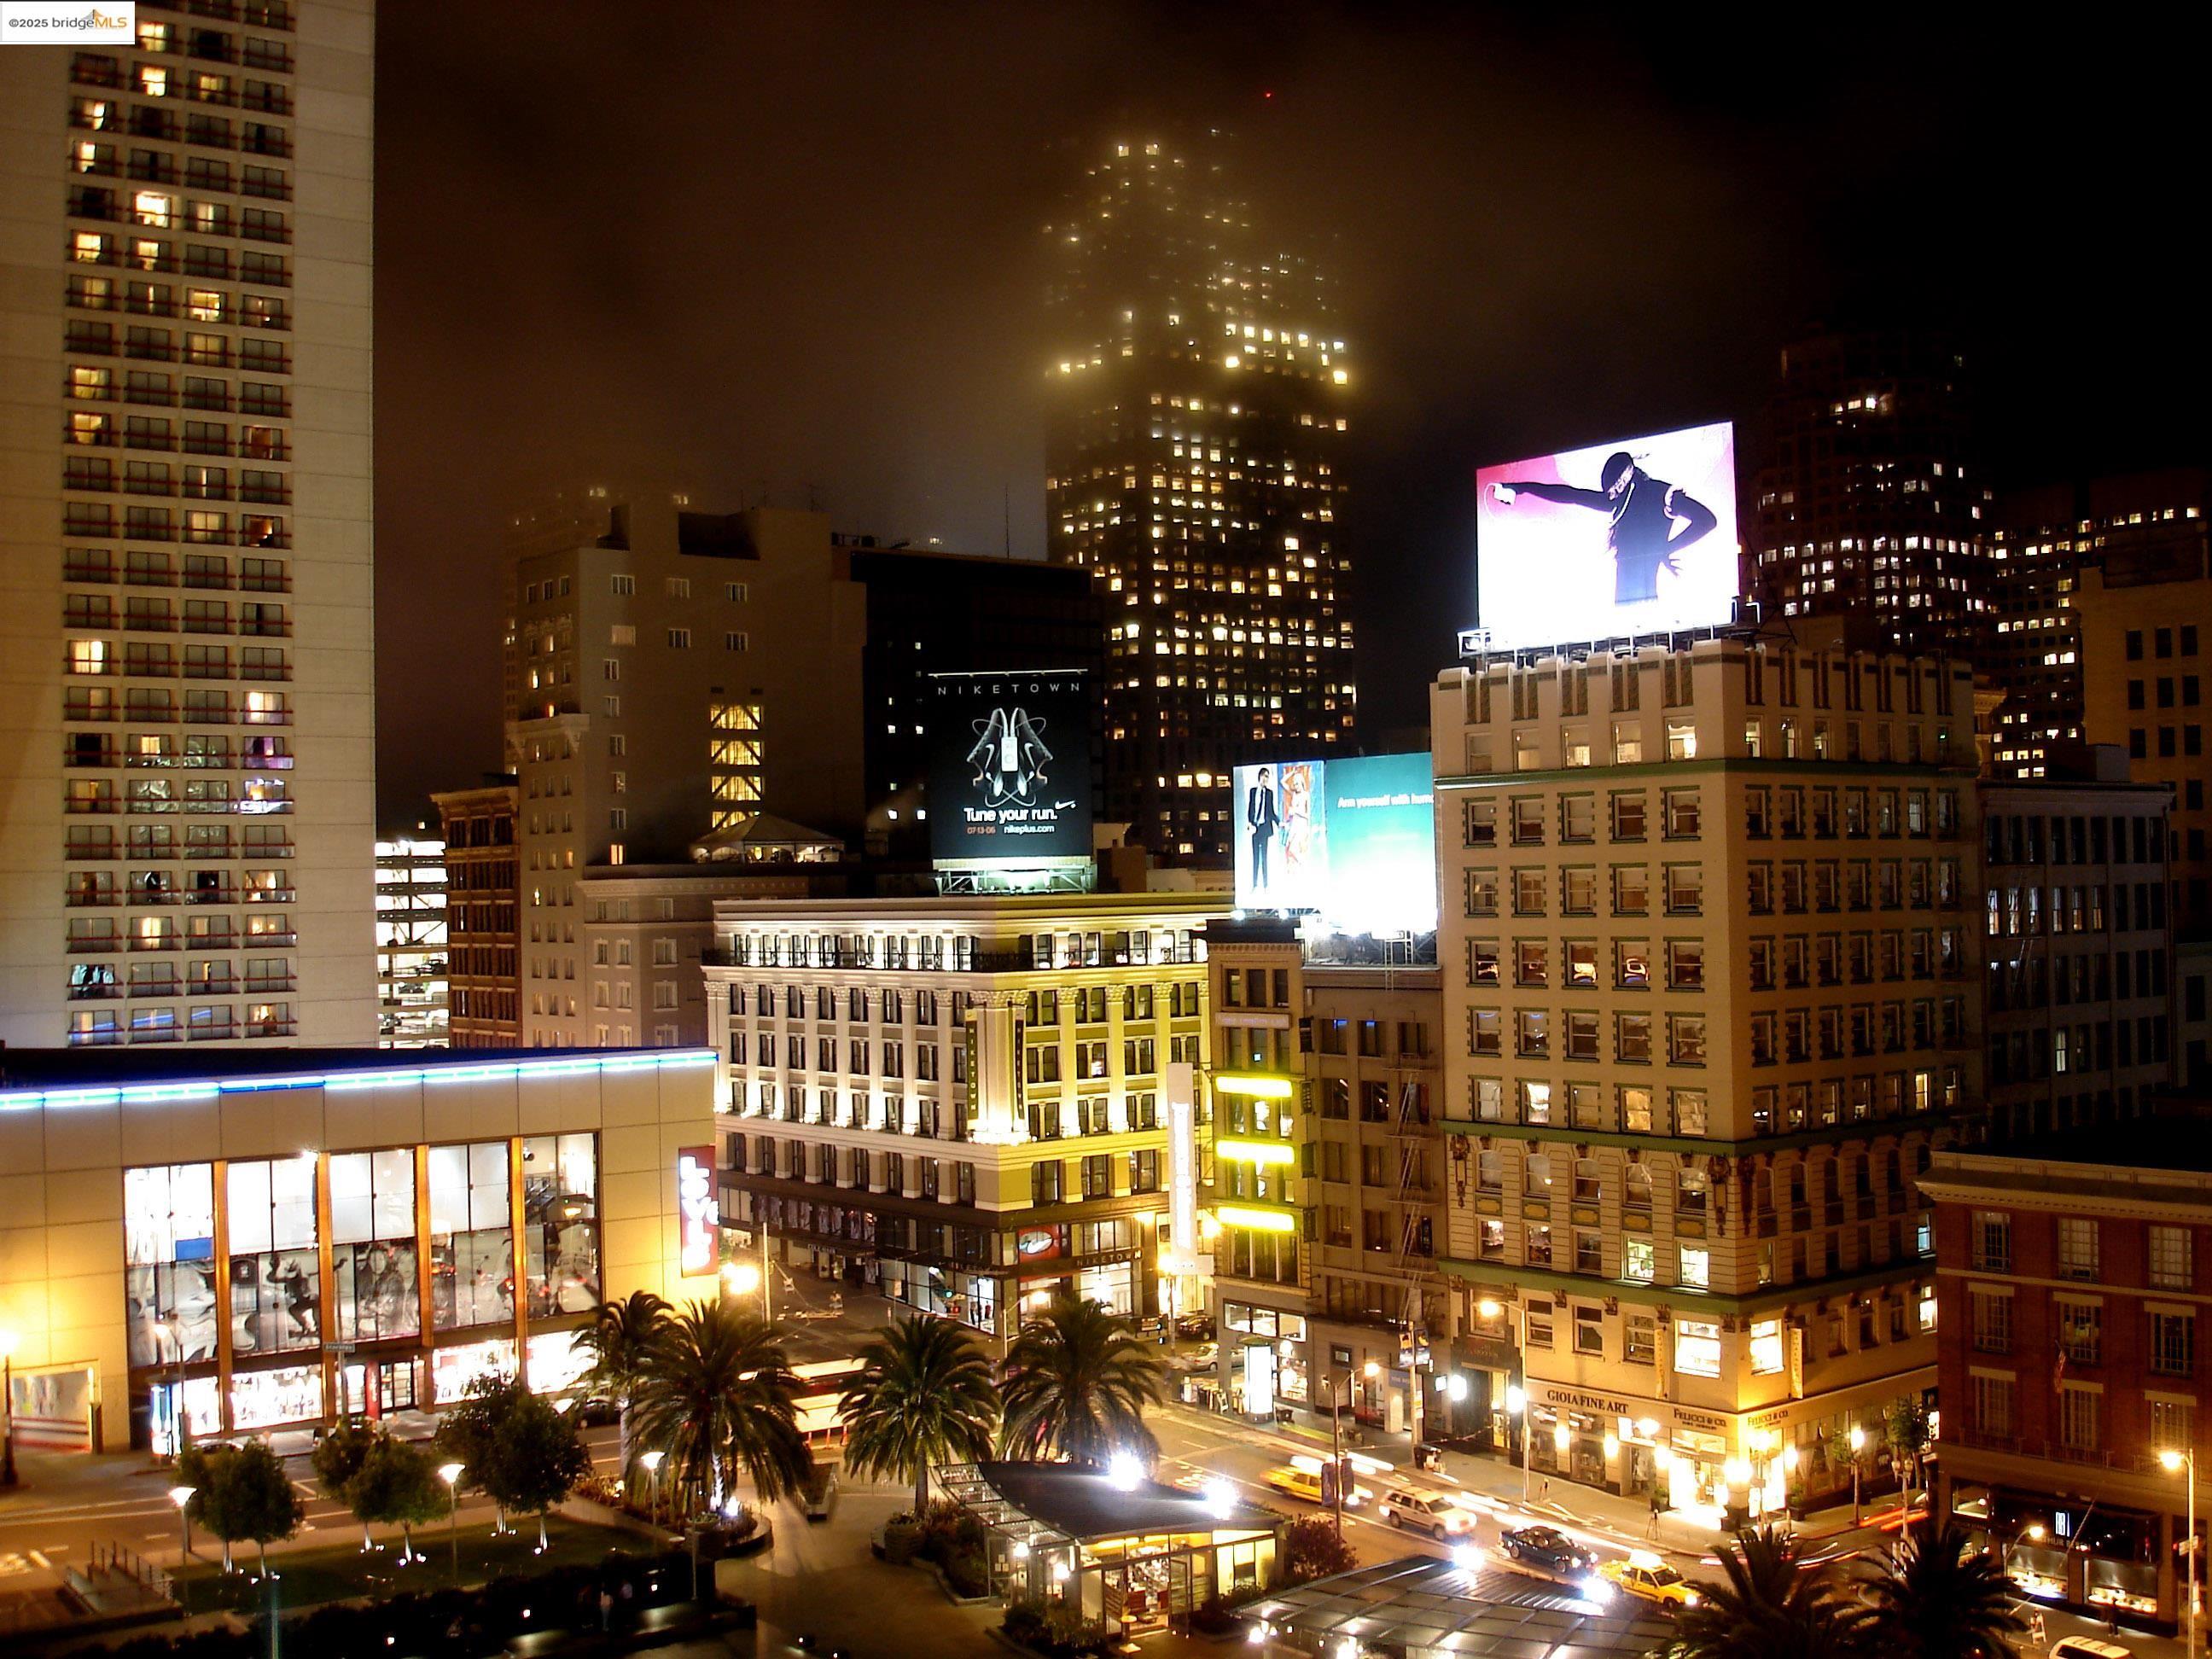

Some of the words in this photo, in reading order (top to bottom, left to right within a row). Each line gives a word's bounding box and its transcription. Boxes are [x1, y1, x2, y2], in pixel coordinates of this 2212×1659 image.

[938, 683, 1080, 696] NIKETOWN
[963, 807, 997, 822] Tune
[998, 808, 1029, 825] your
[1031, 808, 1058, 820] run.
[1004, 824, 1055, 835] nikeplus.com
[1547, 1389, 1579, 1406] GIOIA
[1580, 1395, 1605, 1410] FINE
[1606, 1401, 1629, 1414] ART
[1674, 1408, 1705, 1424] FELICCI
